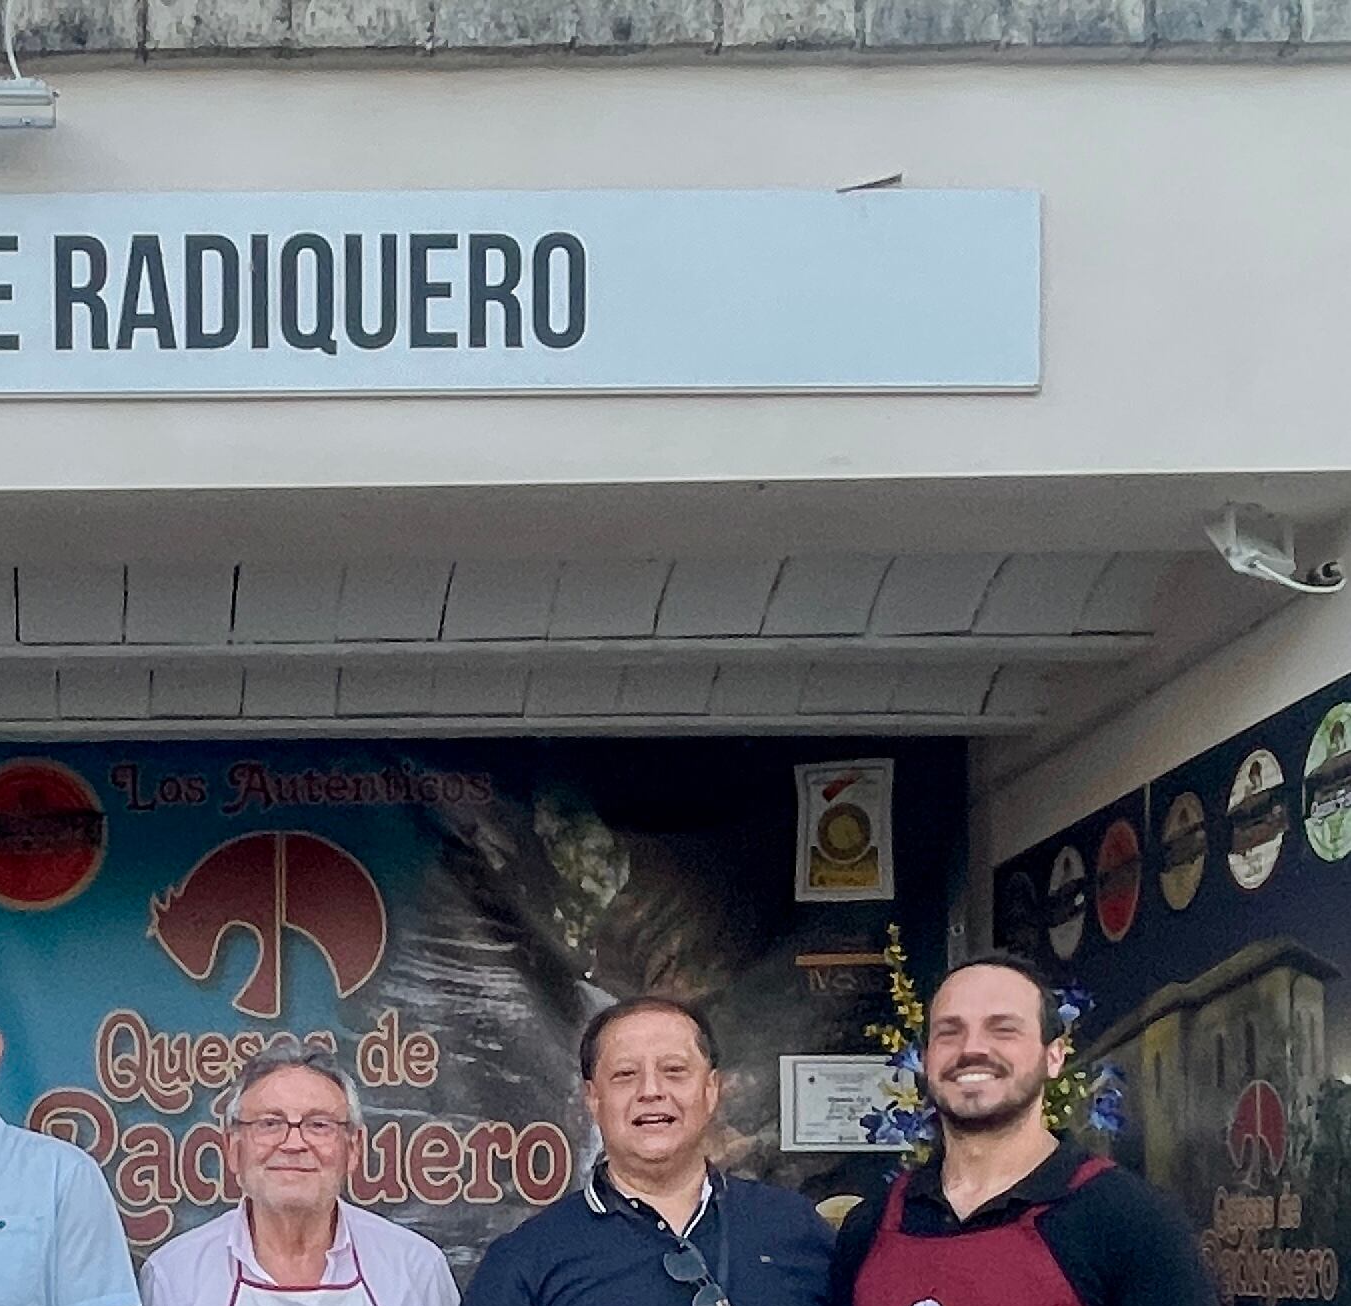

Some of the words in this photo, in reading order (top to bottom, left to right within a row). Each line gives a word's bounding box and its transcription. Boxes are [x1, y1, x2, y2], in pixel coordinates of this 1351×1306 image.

[53, 231, 587, 355] RADIQUERO
[110, 761, 208, 812] Los
[357, 1005, 439, 1088] de
